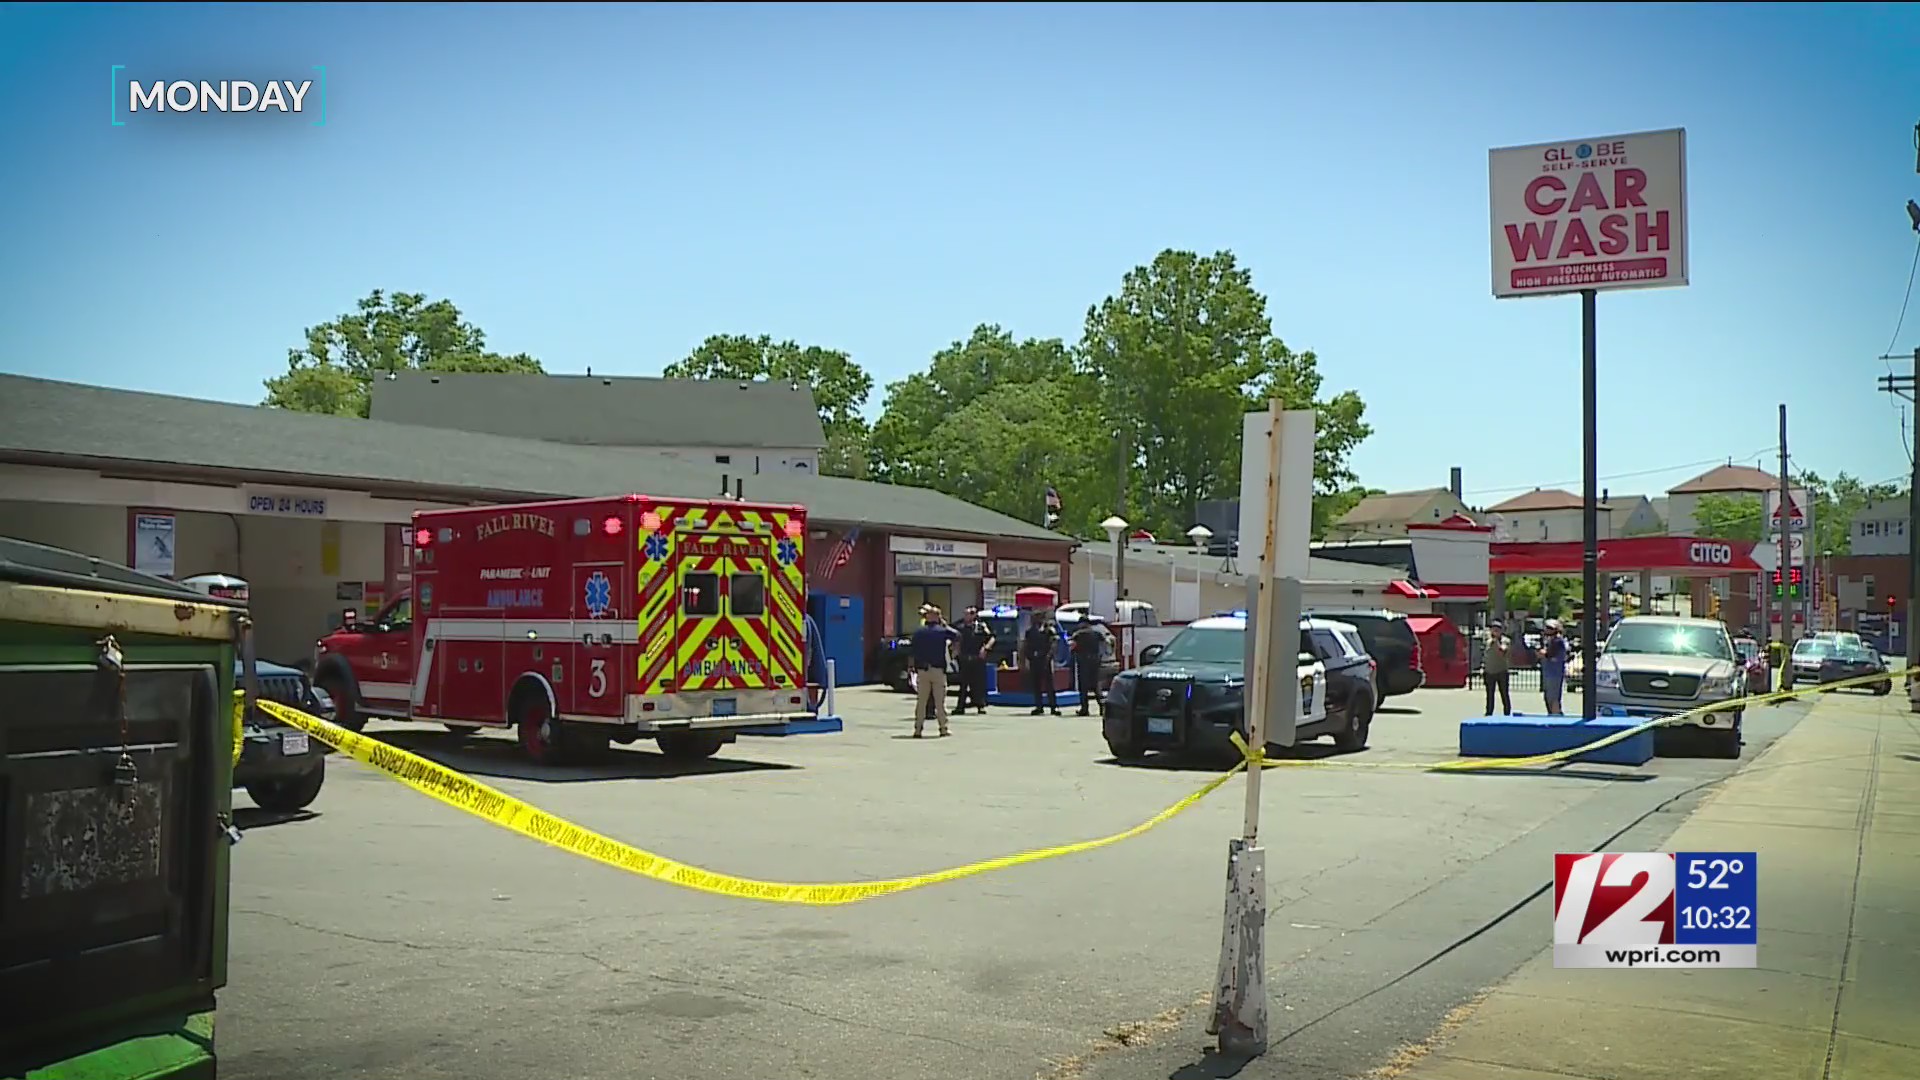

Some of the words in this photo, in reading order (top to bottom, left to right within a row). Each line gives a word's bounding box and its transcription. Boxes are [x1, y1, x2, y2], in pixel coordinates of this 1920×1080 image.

[1544, 141, 1626, 162] GLOBE
[1541, 156, 1629, 172] SELF-SERVE
[1524, 168, 1648, 216] CAR
[1504, 210, 1670, 263] WASH
[1516, 277, 1541, 288] HIGH
[1546, 273, 1596, 285] PRESSURE
[1601, 268, 1661, 281] AUTOMATIC
[1559, 263, 1616, 274] TOUCHLESS
[250, 495, 275, 511] OPEN
[278, 497, 292, 512] 24
[294, 498, 326, 515] HOURS
[476, 514, 510, 541] FALL
[512, 513, 556, 538] RIVER
[682, 543, 718, 555] FALL
[722, 544, 766, 557] RIVER
[1690, 542, 1731, 564] CITGO
[480, 567, 523, 580] PARAMEDIC
[531, 567, 551, 578] UNIT
[380, 652, 389, 669] 3
[684, 659, 762, 677] AMBULANCE
[588, 659, 607, 698] 3
[368, 743, 406, 774] CROSS
[402, 759, 425, 785] NOT
[424, 767, 442, 790] DO
[439, 773, 475, 805] SCENE
[470, 788, 506, 817] CRIME
